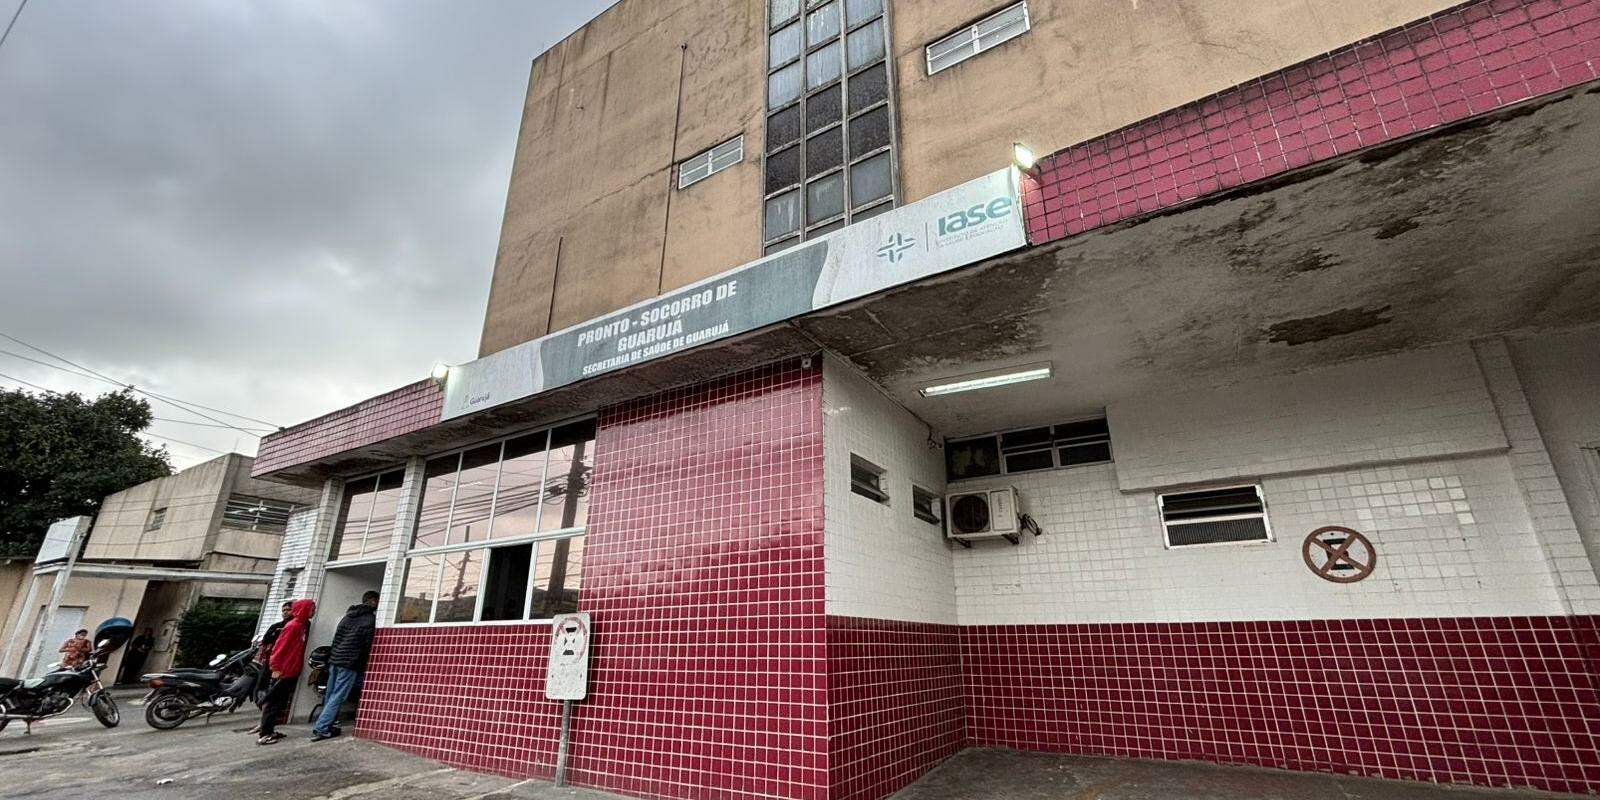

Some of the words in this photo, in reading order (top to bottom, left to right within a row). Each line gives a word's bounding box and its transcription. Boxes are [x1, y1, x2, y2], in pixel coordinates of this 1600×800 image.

[577, 317, 631, 347] PRONTO
[640, 289, 713, 327] SOCORRO
[716, 280, 737, 301] DE
[617, 314, 683, 352] GUARUJÁ
[582, 352, 630, 375] SECRETARIA
[631, 349, 642, 361] DE
[642, 340, 672, 358] SAÚDE
[673, 337, 685, 349] DE
[686, 320, 729, 345] GUARUJÁ
